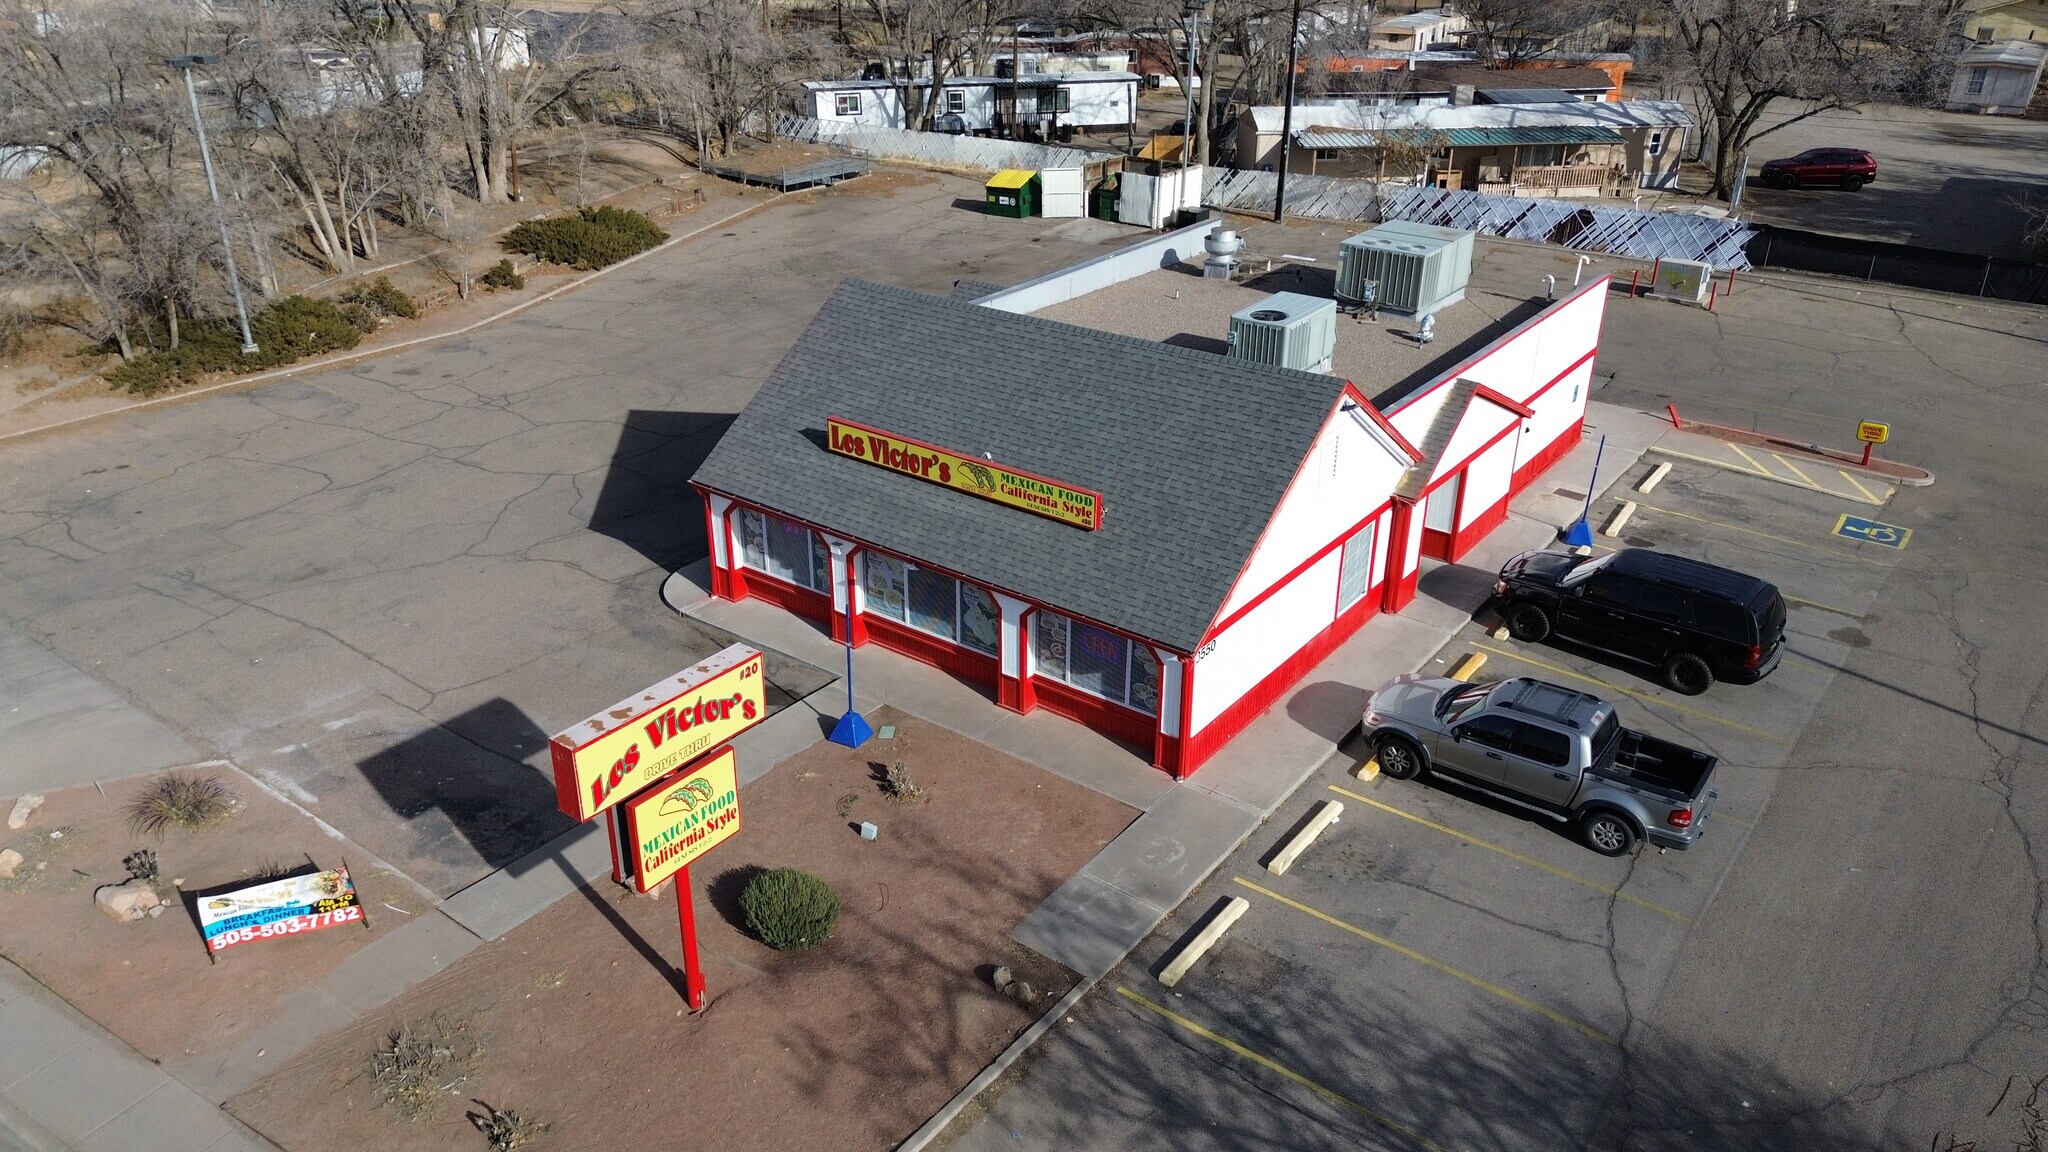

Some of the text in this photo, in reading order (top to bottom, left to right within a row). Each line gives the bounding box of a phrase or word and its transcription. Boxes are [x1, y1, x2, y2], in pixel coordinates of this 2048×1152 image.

[831, 424, 951, 483] Los Victor's
[1000, 473, 1054, 496] MEXICAN
[1058, 489, 1093, 507] FOOD
[1000, 483, 1058, 509] California
[1062, 501, 1093, 518] Style
[1026, 503, 1051, 514] GENESIS
[1081, 518, 1092, 526] #20
[1084, 632, 1119, 660] OPEN
[739, 662, 759, 681] #20
[590, 692, 758, 812] Los Victor's
[643, 733, 711, 781] DRIVE THRU
[642, 790, 735, 858] MEXICAN FOOD
[644, 807, 737, 873] California Style
[213, 908, 237, 918] Mexican
[337, 894, 354, 902] TO
[209, 919, 247, 937] LUNCH
[263, 908, 306, 924] DINNER
[212, 907, 360, 950] 505-503-7782
[223, 907, 287, 925] BREAKFAS
